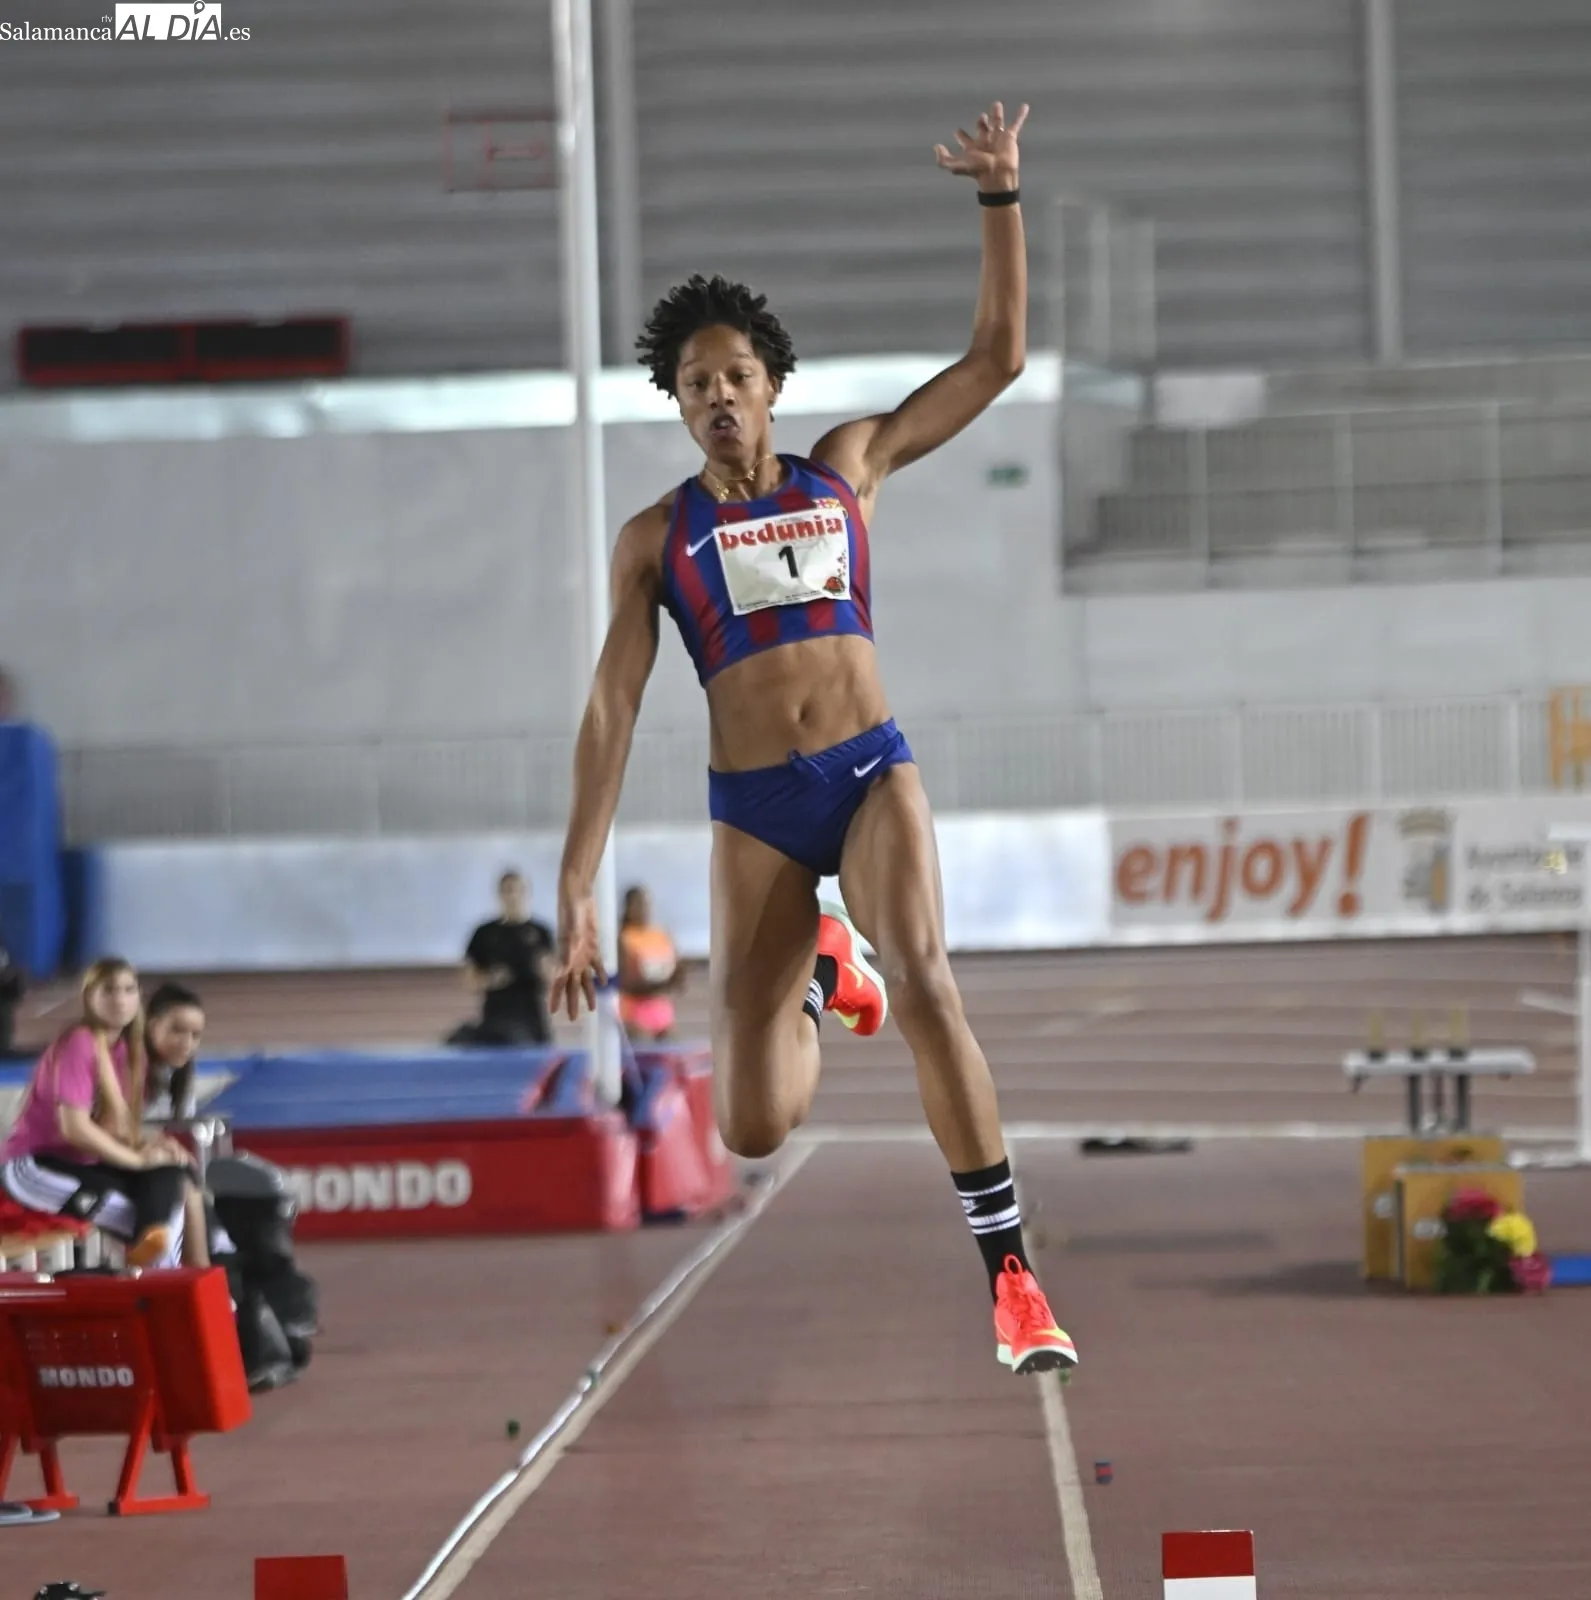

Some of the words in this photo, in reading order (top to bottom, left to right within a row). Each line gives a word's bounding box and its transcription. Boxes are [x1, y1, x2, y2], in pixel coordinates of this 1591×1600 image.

[719, 515, 843, 551] bedunia
[778, 545, 799, 578] 1
[1114, 811, 1369, 923] enjoy!
[39, 1366, 134, 1387] MONDO
